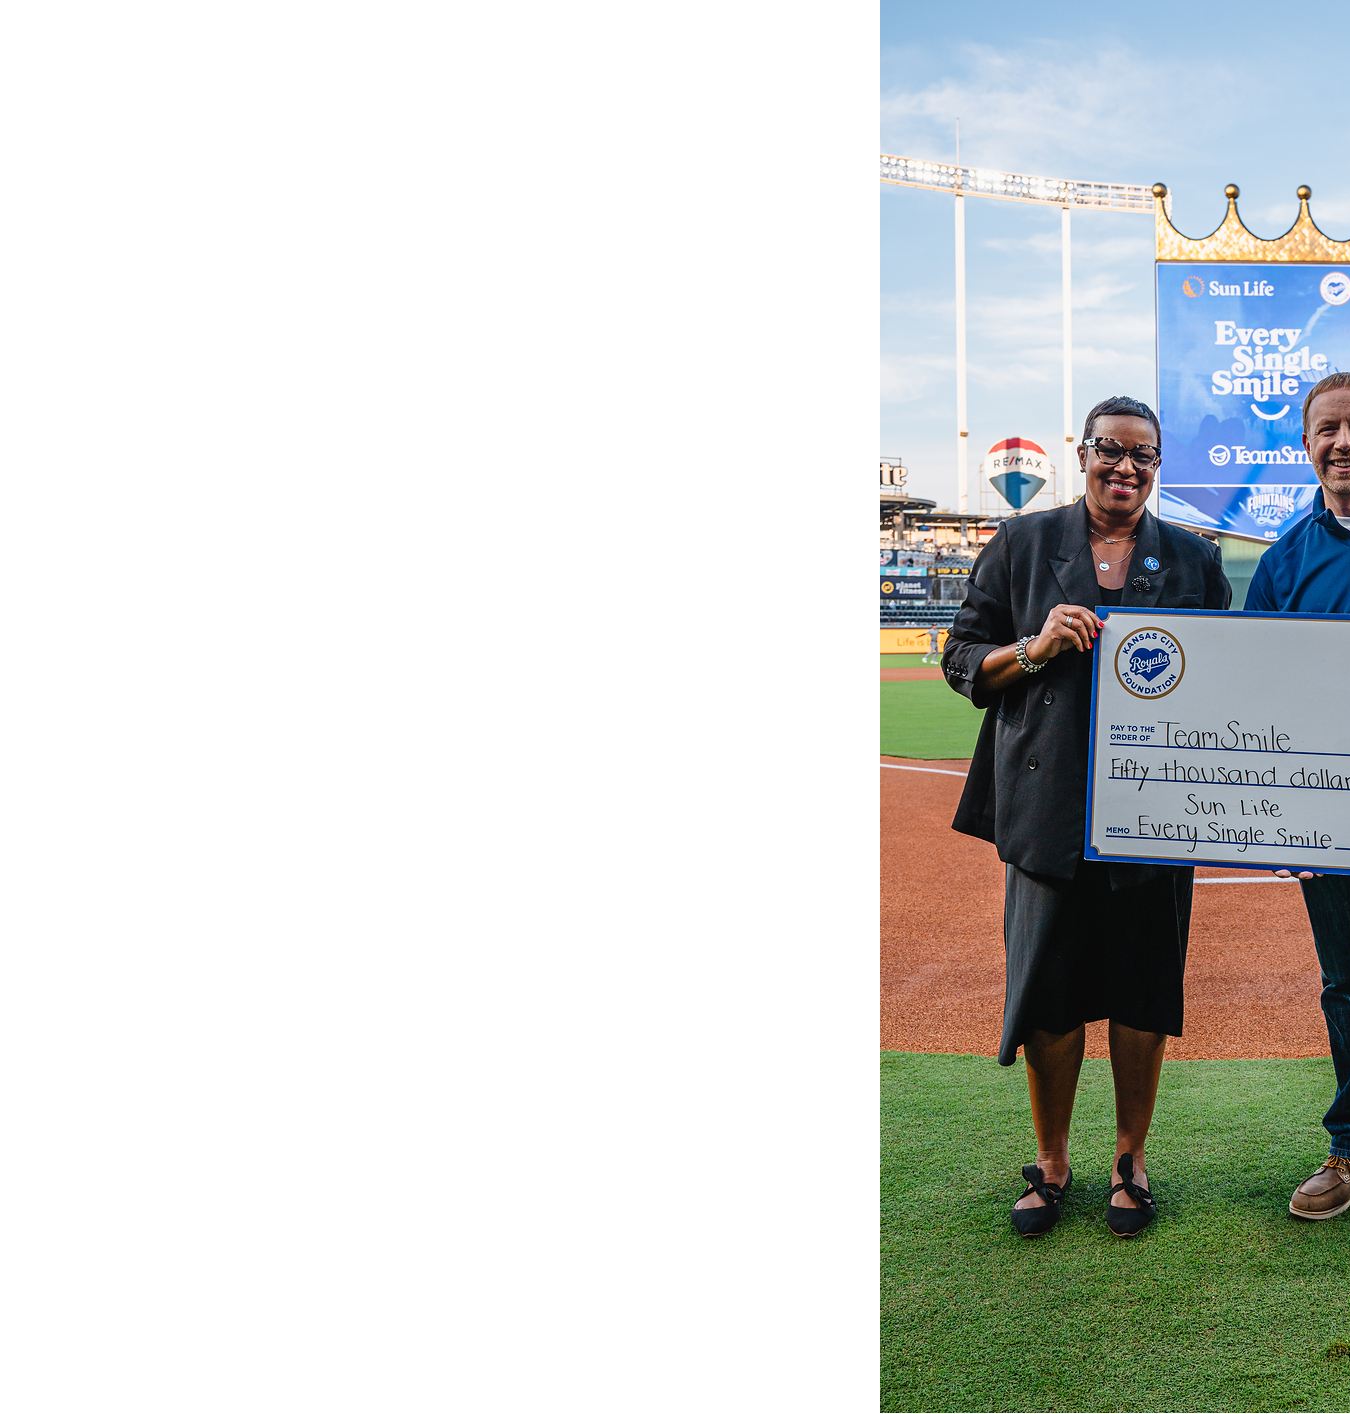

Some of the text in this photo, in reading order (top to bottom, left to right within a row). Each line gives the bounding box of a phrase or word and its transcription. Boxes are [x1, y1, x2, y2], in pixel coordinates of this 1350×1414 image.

[1209, 281, 1275, 296] Sun Life
[1214, 320, 1302, 352] Every
[1231, 346, 1328, 377] Single
[1211, 370, 1300, 401] Smile
[993, 456, 1042, 469] RE/MAX
[1231, 445, 1312, 465] TeamSm
[880, 463, 908, 486] te
[1247, 493, 1295, 513] FOUNTAINS
[895, 581, 921, 590] planet
[899, 587, 927, 595] fitness
[896, 637, 915, 647] Life
[916, 637, 925, 647] is
[1123, 633, 1179, 655] KANSAS CITY
[1129, 652, 1171, 675] Royals
[1121, 671, 1177, 695] FOUNDATION
[1110, 724, 1126, 732] PAY
[1140, 725, 1155, 733] THE
[1110, 733, 1138, 741] ORDER
[1157, 720, 1292, 752] TeamSmile
[1111, 757, 1149, 791] Fifty
[1158, 759, 1276, 786] thousand
[1184, 793, 1283, 818] Sun Life
[1106, 826, 1130, 835] MEMO
[1138, 815, 1332, 853] Every Single Smile
